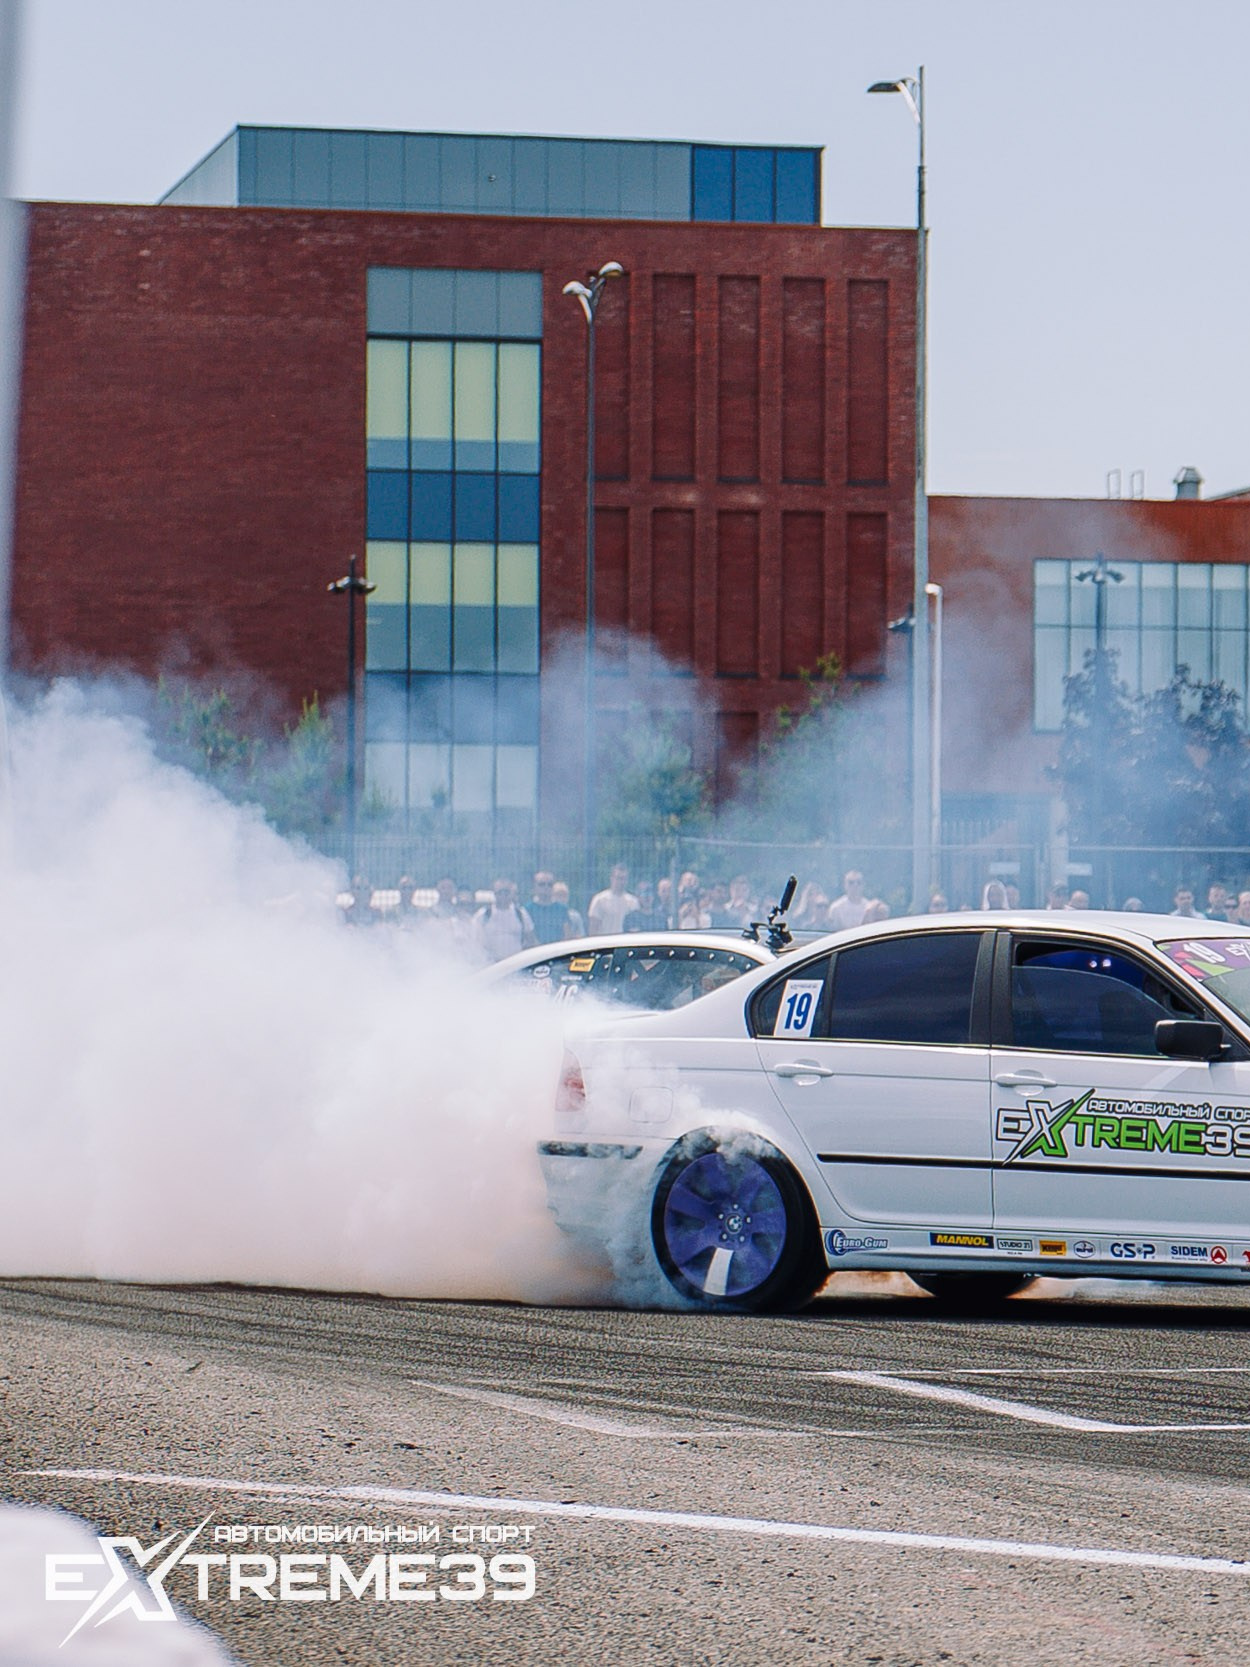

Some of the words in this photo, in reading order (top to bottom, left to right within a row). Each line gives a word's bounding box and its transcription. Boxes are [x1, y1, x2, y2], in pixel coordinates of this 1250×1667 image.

[784, 992, 812, 1030] 19
[1086, 1098, 1210, 1120] АВТОМОБИЛЬНЫЙ
[935, 1233, 990, 1247] MANNOL
[1170, 1245, 1208, 1257] SIDEM
